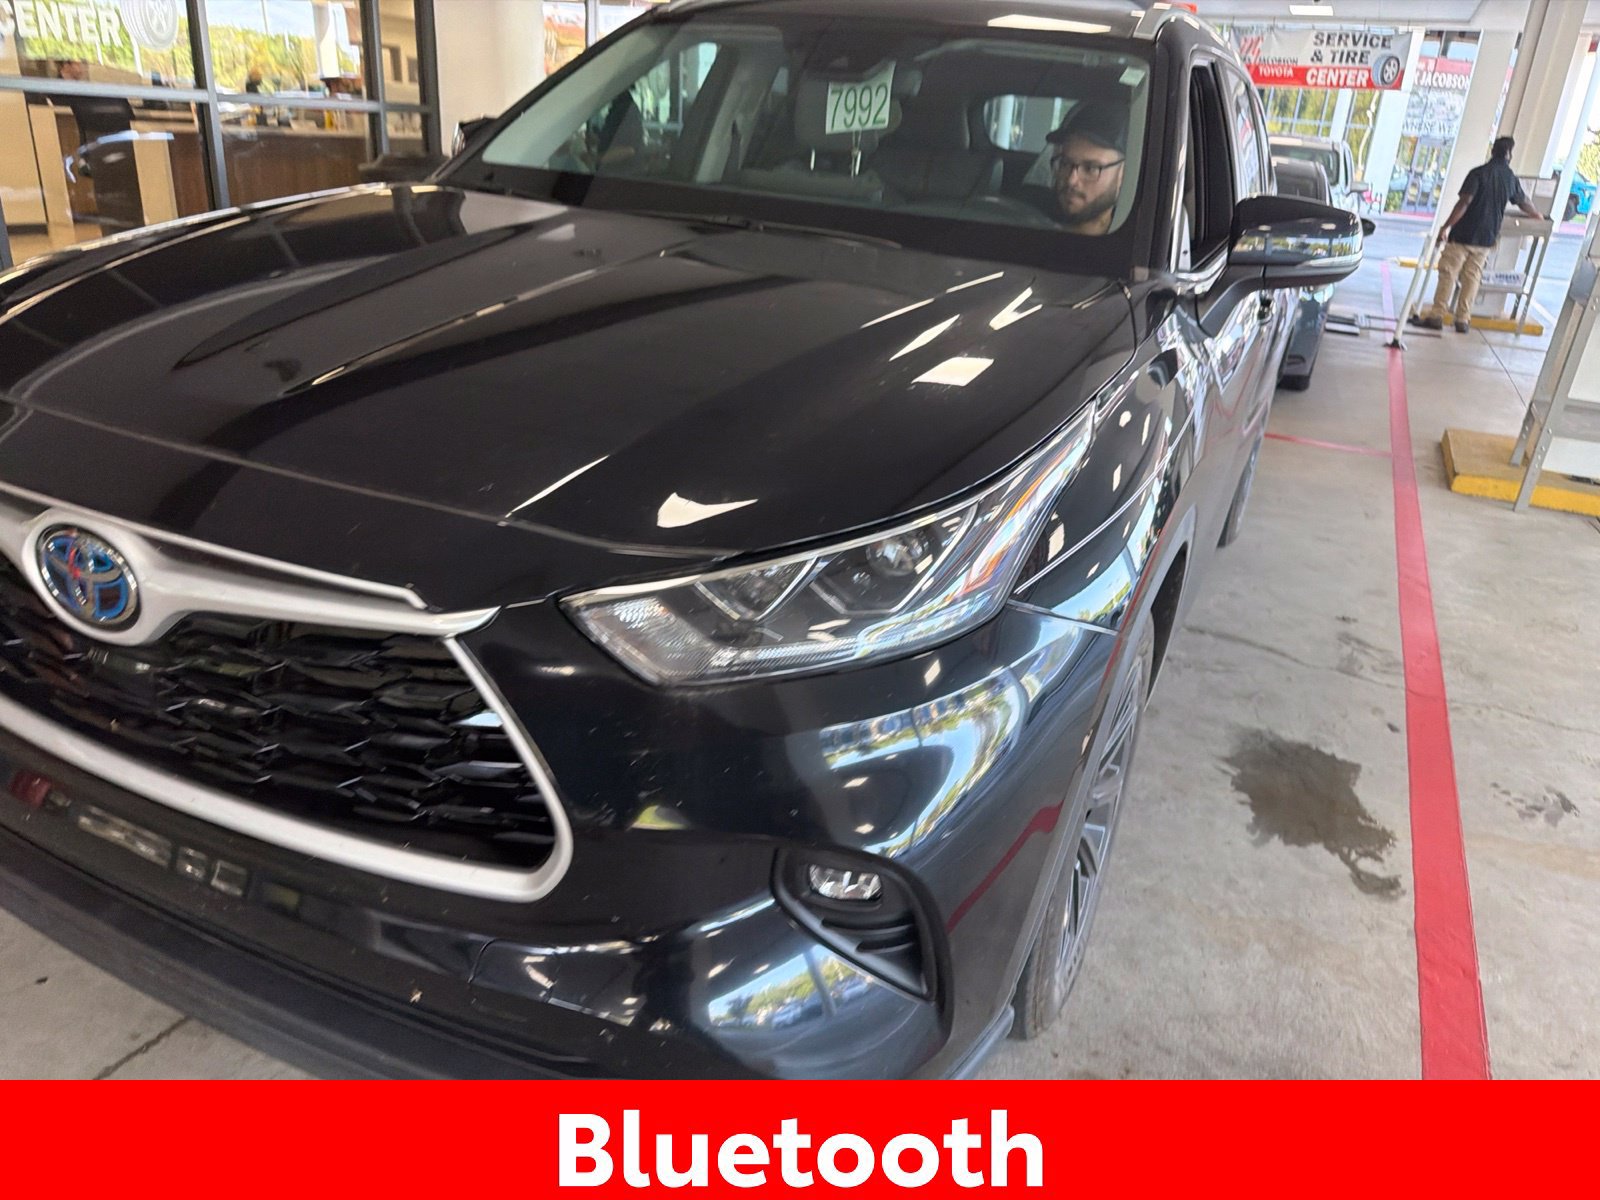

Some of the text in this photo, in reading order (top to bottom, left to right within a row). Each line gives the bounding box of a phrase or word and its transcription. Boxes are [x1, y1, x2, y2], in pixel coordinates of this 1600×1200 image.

[1313, 31, 1393, 49] SERVICE
[1310, 48, 1371, 64] & TIRE
[1258, 65, 1294, 78] TOYOTA
[1306, 67, 1370, 87] CENTER
[830, 82, 889, 130] 7992
